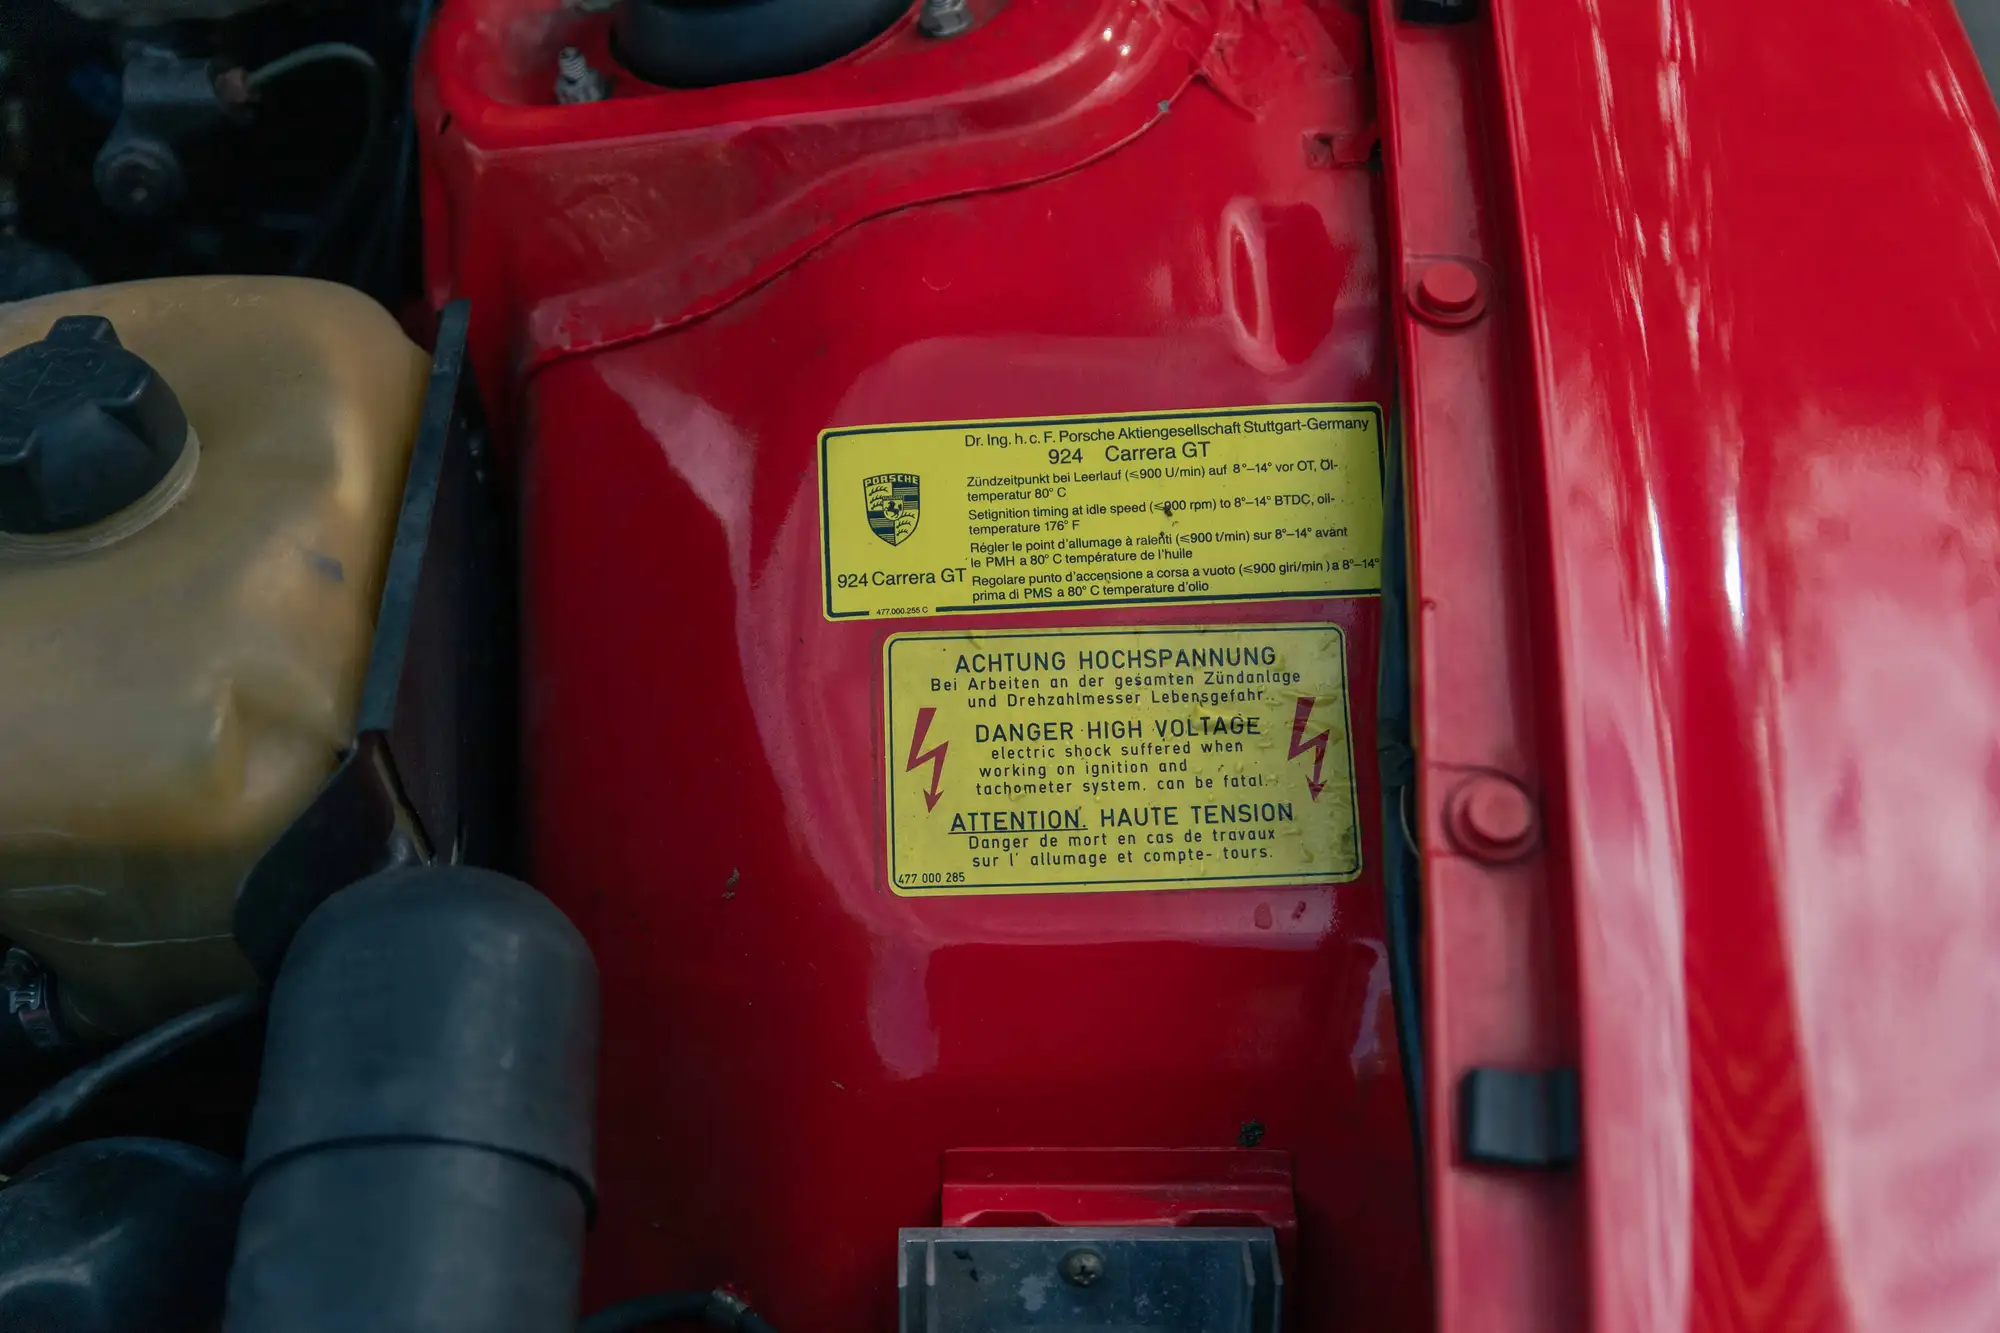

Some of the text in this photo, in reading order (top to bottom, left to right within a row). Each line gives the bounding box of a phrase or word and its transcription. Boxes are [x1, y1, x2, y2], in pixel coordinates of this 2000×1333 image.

[965, 435, 983, 447] Dr.
[987, 434, 1011, 448] Ing.
[1044, 431, 1055, 443] F.
[1059, 429, 1115, 442] Porsche
[1118, 422, 1241, 440] Aktiengesellschaft
[1244, 418, 1368, 435] Stuttgart-Germany
[1048, 441, 1211, 464] 924 Carrera GT
[864, 474, 919, 487] PORSCHE
[967, 473, 1050, 487] Zündzeitpunkt
[1053, 473, 1070, 483] bei
[1074, 470, 1121, 482] Leerlauf
[1165, 466, 1205, 478] U/min)
[1209, 464, 1227, 475] auf
[1275, 464, 1294, 472] vor
[1297, 460, 1316, 472] OT,
[967, 490, 1031, 503] temperatur
[1057, 487, 1066, 497] C
[969, 508, 1030, 521] Setignition
[1033, 506, 1068, 518] timing
[1072, 505, 1083, 515] at
[1086, 504, 1107, 515] idle
[1110, 502, 1146, 516] speed
[1190, 498, 1216, 512] rpm)
[1220, 499, 1231, 508] to
[1275, 494, 1314, 507] BTDC,
[969, 523, 1040, 536] temperature
[1072, 520, 1080, 530] F
[971, 542, 1009, 555] Régler
[1012, 541, 1022, 551] le
[1026, 540, 1055, 553] point
[1126, 536, 1133, 546] à
[1215, 530, 1250, 543] t/min)
[1253, 532, 1272, 540] sur
[1316, 527, 1347, 538] avant
[971, 558, 981, 568] le
[986, 556, 1015, 567] PMH
[1020, 558, 1027, 566] a
[1053, 553, 1062, 564] C
[1065, 552, 1137, 565] température
[1140, 550, 1155, 560] de
[838, 568, 967, 588] 924 Carrera GT
[972, 575, 1025, 588] Regolare
[1029, 573, 1062, 586] punto
[1157, 569, 1189, 578] corsa
[1193, 568, 1200, 576] a
[1202, 565, 1235, 576] vuoto
[1332, 562, 1339, 570] a
[973, 590, 1006, 603] prima
[1009, 589, 1019, 599] di
[1024, 587, 1052, 599] PMS
[1057, 589, 1064, 597] a
[1090, 585, 1099, 595] C
[1103, 584, 1174, 596] temperature
[955, 646, 1275, 673] ACHTUNG HOCHSPANNUNG
[931, 670, 1300, 691] Bei Arbeiten an der gesamten Zündanlage
[968, 689, 1263, 708] und Drehzahlmesser Lebensgefahr
[976, 717, 1261, 743] DANGER HIGH VOLTAGE
[992, 740, 1243, 759] electric shock suffered when
[979, 758, 1187, 779] working on ignition and
[976, 781, 1072, 797] tachometer
[1157, 780, 1184, 790] can
[1196, 776, 1213, 788] be
[1224, 774, 1268, 787] fatal.
[1101, 807, 1178, 827] HAUTE
[1190, 803, 1293, 824] TENSION
[969, 829, 1275, 852] Danger de mort en cas de travaux
[973, 857, 999, 867] sur
[1031, 852, 1107, 867] allumage
[1118, 851, 1132, 863] et
[898, 872, 965, 884] 477 000 285
